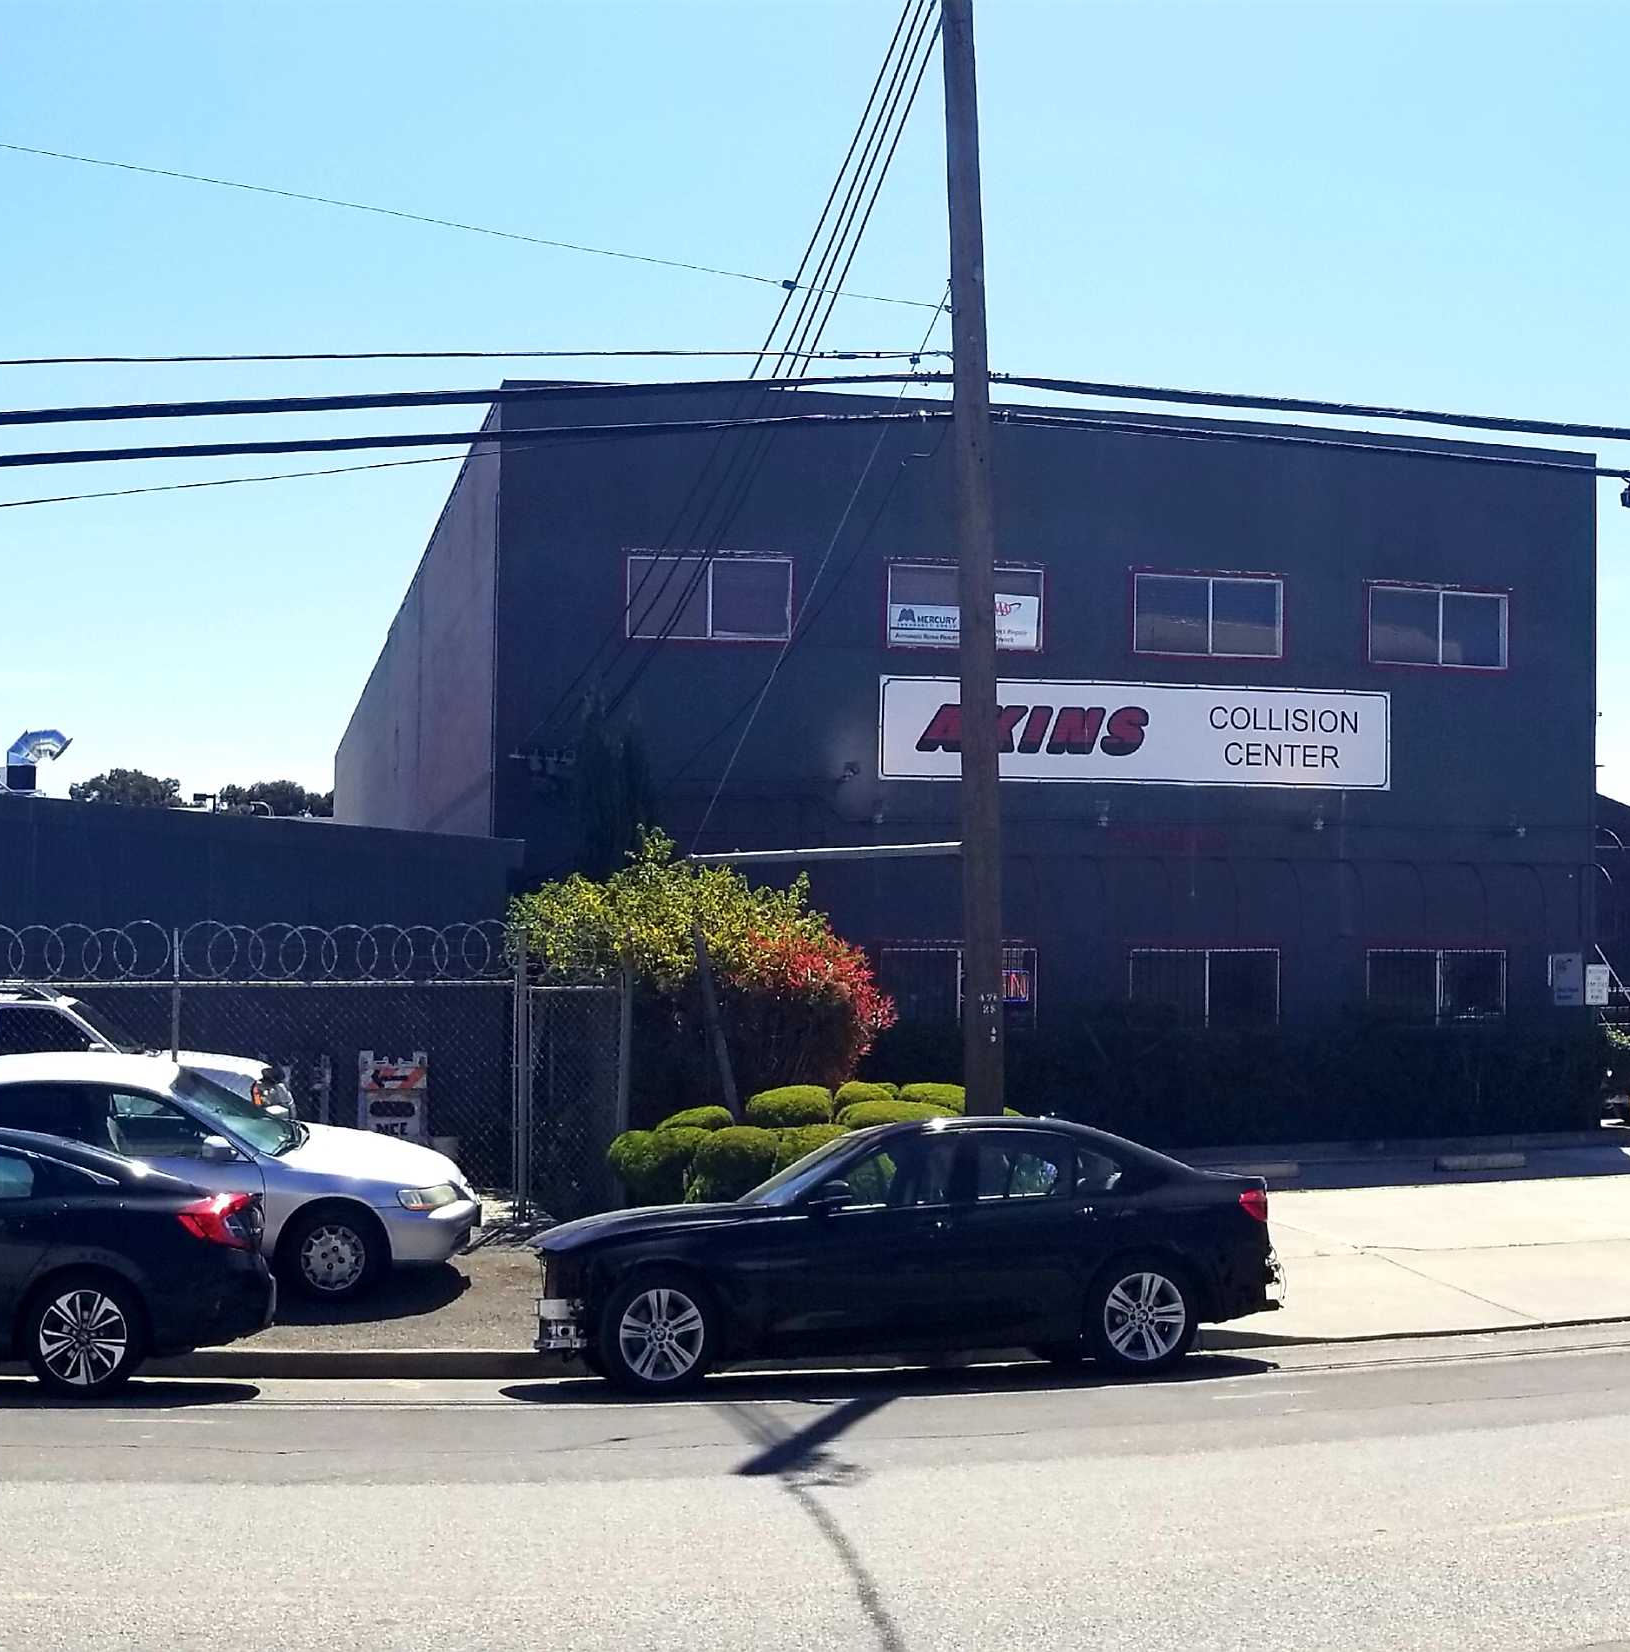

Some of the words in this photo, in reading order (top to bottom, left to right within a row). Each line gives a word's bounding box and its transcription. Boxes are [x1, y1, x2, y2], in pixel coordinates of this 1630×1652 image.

[917, 615, 957, 624] MERCURY
[1209, 706, 1359, 734] COLLISION
[1223, 742, 1340, 769] CENTER
